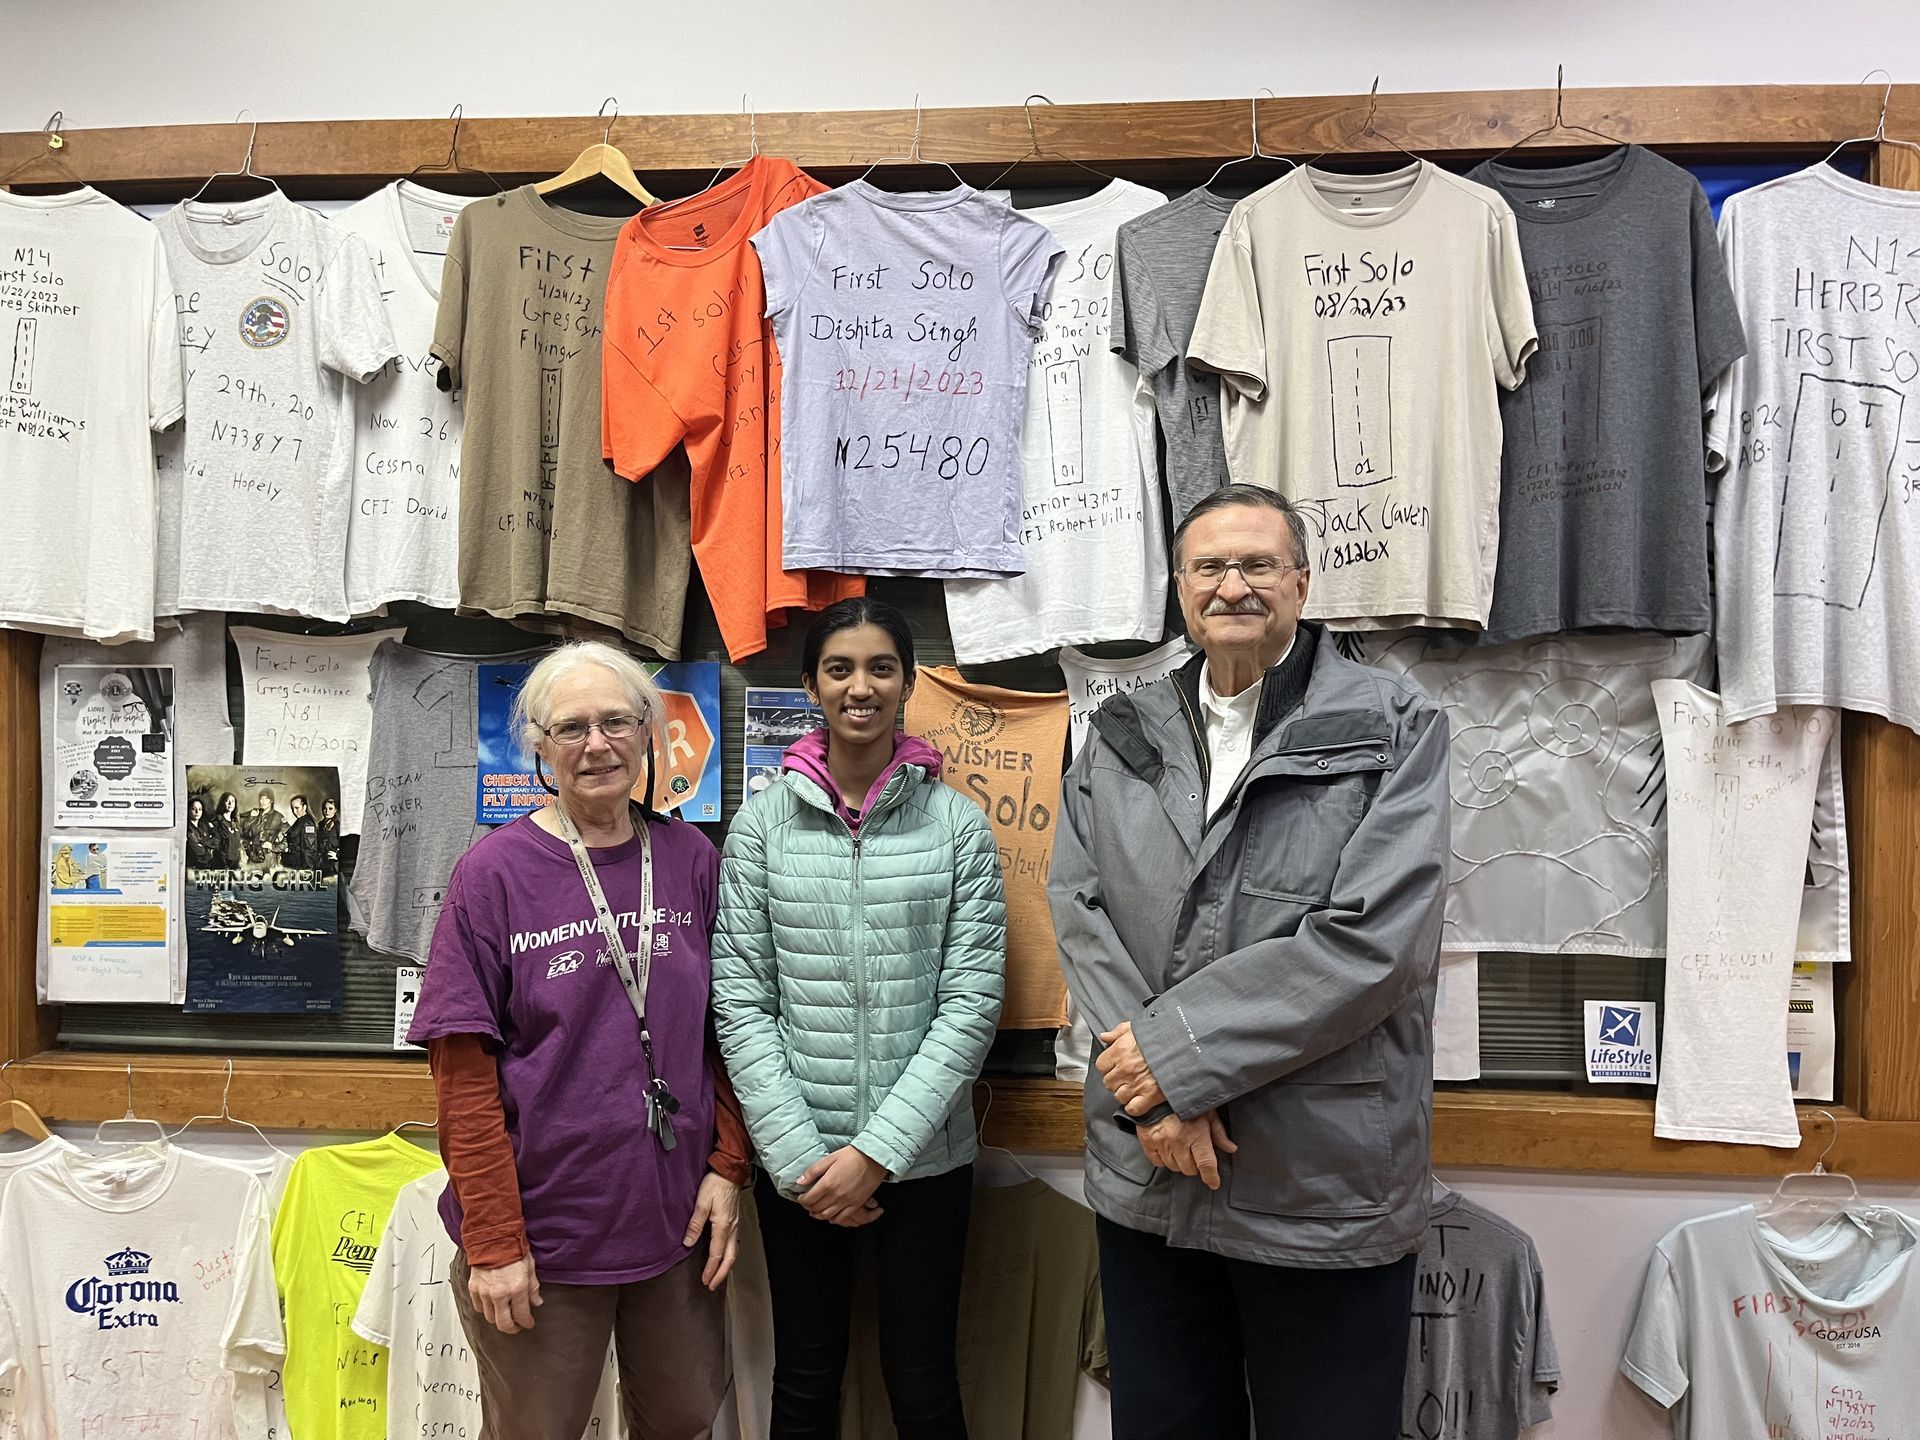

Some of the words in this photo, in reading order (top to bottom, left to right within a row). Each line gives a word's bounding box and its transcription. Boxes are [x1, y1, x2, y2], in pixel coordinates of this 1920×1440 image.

[15, 248, 49, 267] N14
[520, 246, 594, 282] First
[1304, 252, 1351, 286] First
[1358, 251, 1414, 286] Solo
[832, 266, 889, 290] First
[911, 261, 974, 290] Solo
[1795, 267, 1883, 313] HERB
[27, 301, 80, 315] Skinner
[1315, 285, 1406, 319] 08/22/23
[809, 315, 894, 349] Dishita
[907, 313, 977, 361] Singh
[1771, 318, 1869, 369] FIRST
[835, 363, 985, 402] 12/21/2023
[366, 452, 424, 475] Cessna
[835, 431, 990, 480] N25480
[1355, 458, 1375, 475] 01
[407, 498, 447, 519] David
[1316, 498, 1372, 537] Jack
[1050, 515, 1097, 533] Robert
[1086, 678, 1121, 697] Keith
[1674, 702, 1724, 728] First
[964, 738, 982, 746] TRACK
[983, 736, 996, 744] AND
[366, 773, 422, 805] BRIAN
[483, 774, 530, 786] CHECK
[483, 794, 509, 806] FLY
[966, 774, 1050, 831] Solo
[272, 870, 328, 891] GIRL
[1720, 952, 1774, 967] KEVIN
[401, 969, 414, 977] Do
[1591, 1049, 1652, 1067] LifeStyle
[340, 1211, 374, 1235] CFI
[66, 1276, 180, 1316] Corona
[1733, 1291, 1808, 1318] FIRST
[98, 1307, 158, 1330] Extra
[1816, 1329, 1853, 1341] GOAT
[1855, 1326, 1881, 1339] USA
[1831, 1386, 1864, 1400] C172
[1825, 1400, 1876, 1415] N738YT
